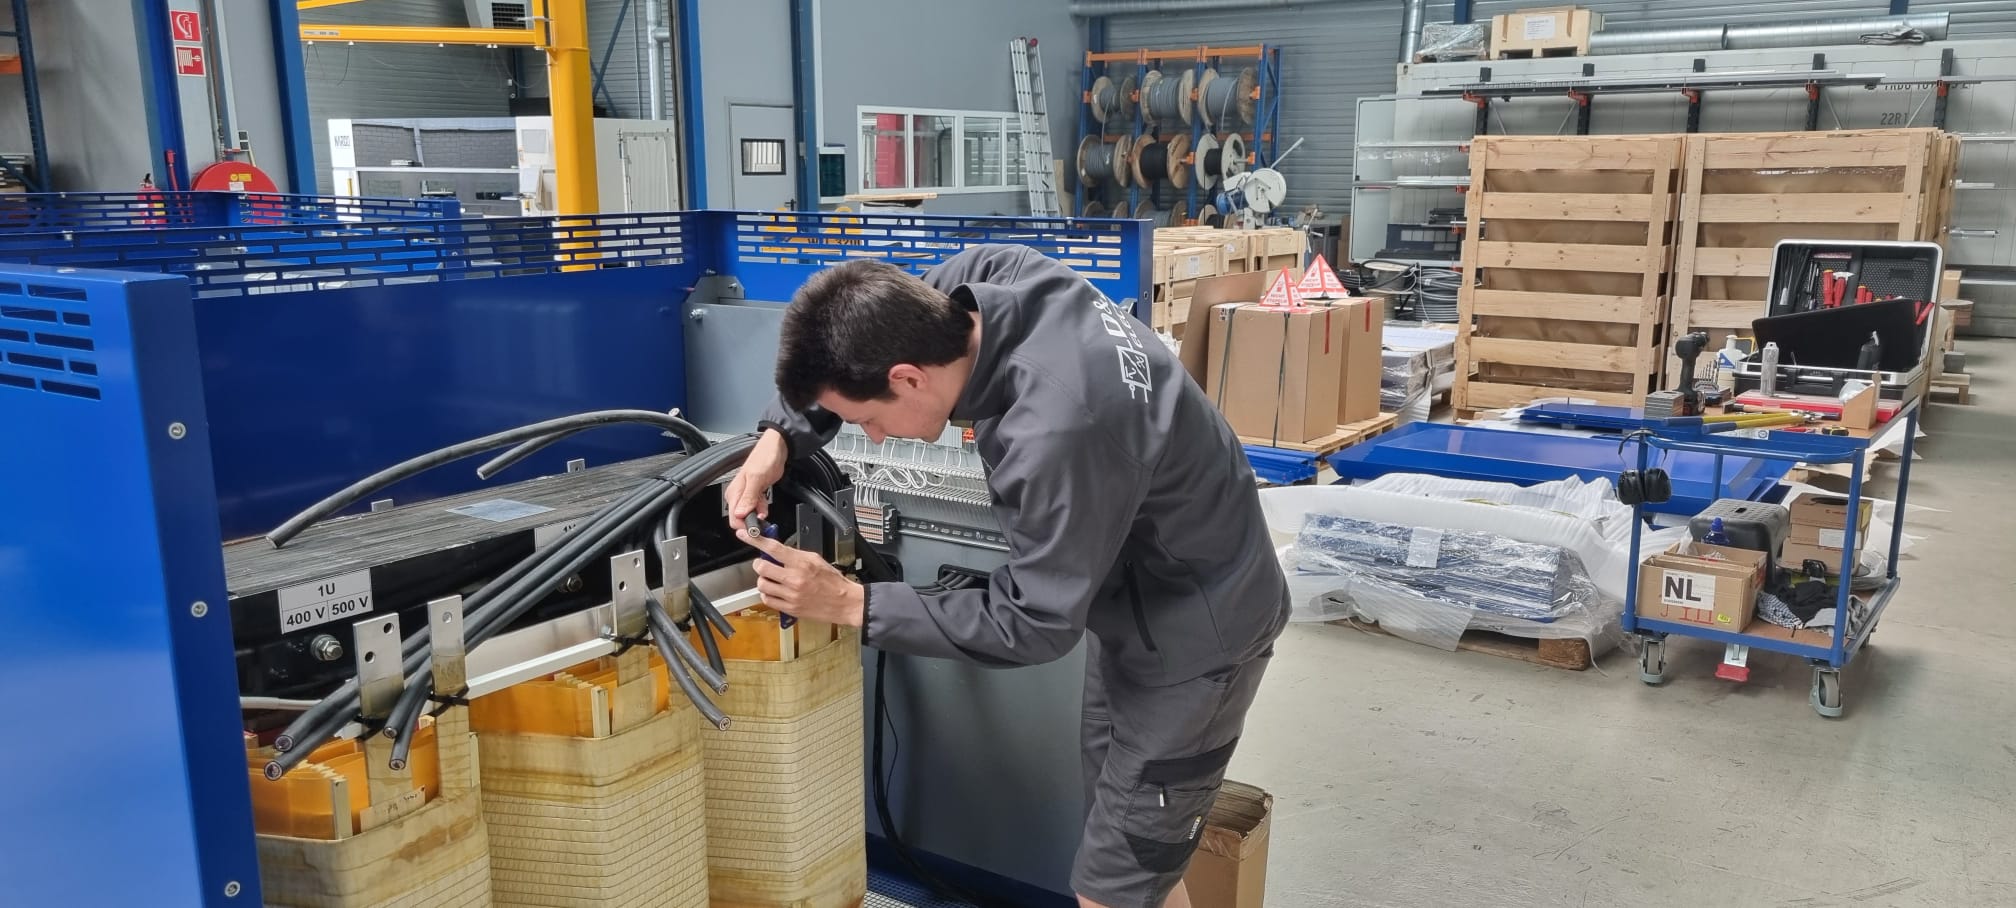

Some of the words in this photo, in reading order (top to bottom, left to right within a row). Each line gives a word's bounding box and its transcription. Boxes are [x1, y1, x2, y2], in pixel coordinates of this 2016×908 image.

[317, 582, 336, 597] 1U
[1664, 575, 1702, 602] NL
[332, 599, 356, 616] 500
[358, 595, 369, 608] V
[286, 610, 311, 626] 400
[315, 606, 326, 619] V
